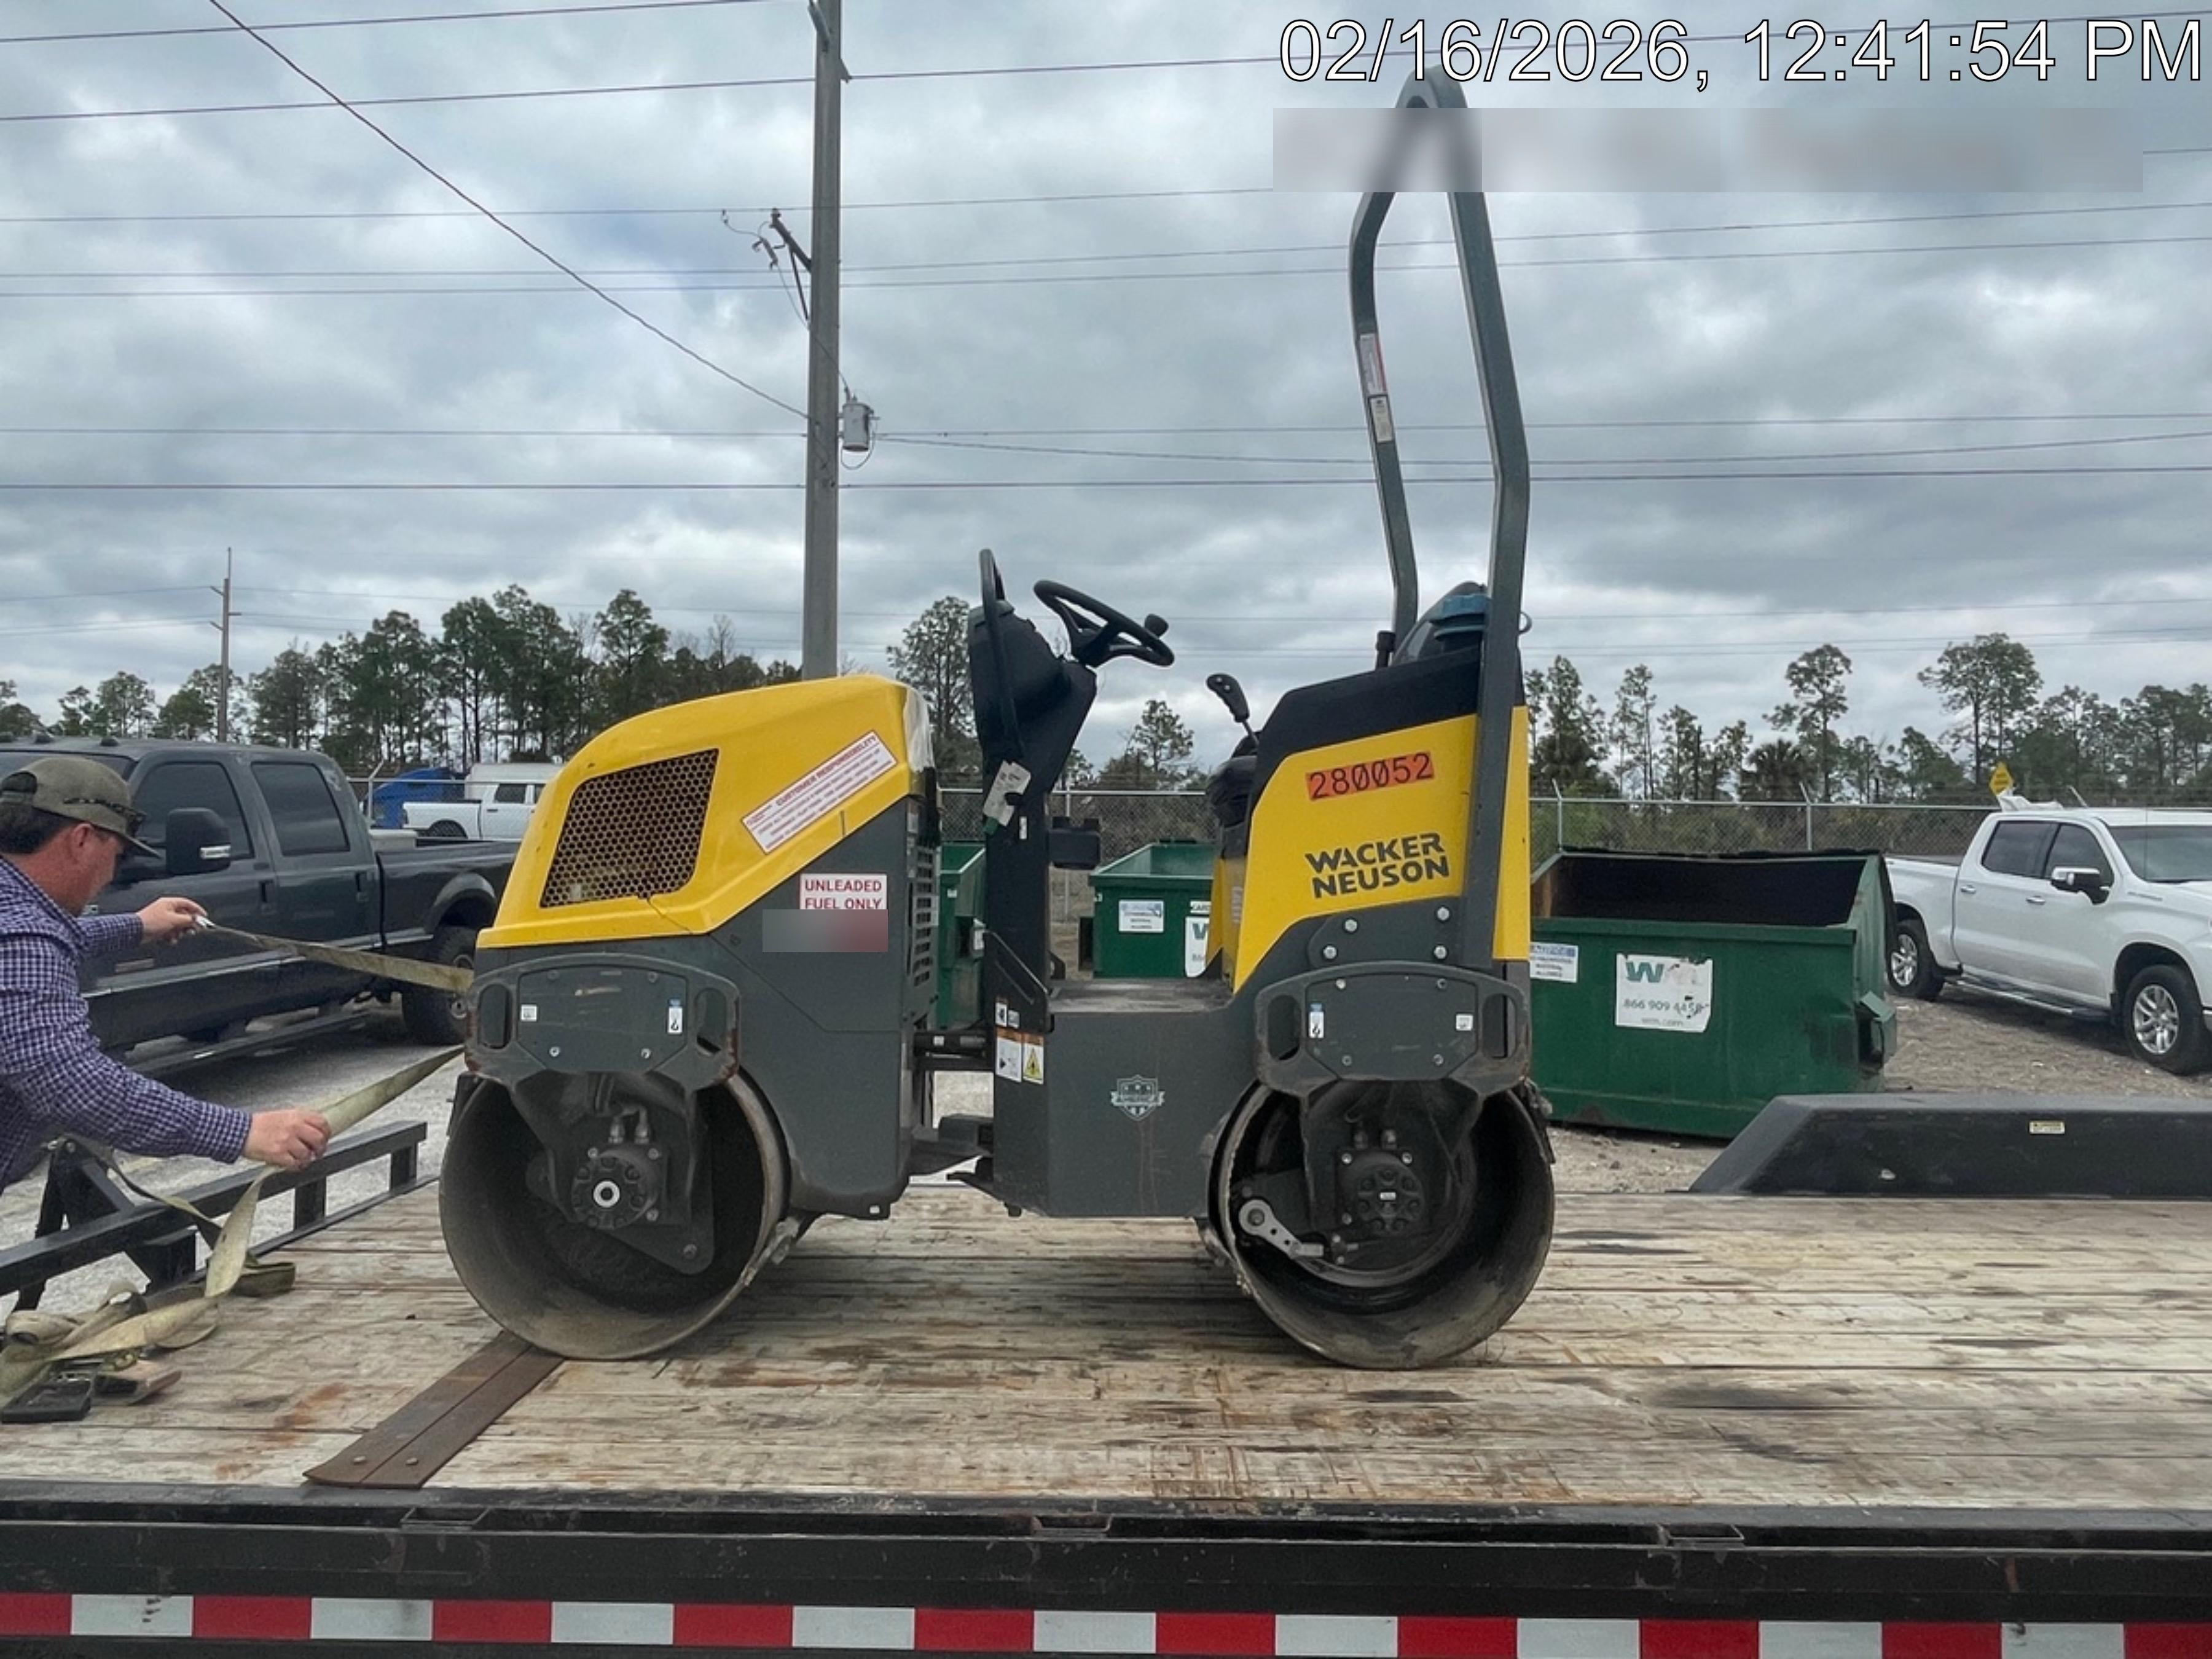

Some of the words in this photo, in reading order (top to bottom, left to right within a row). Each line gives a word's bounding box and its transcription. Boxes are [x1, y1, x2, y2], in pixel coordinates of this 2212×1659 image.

[775, 775, 817, 806] CUSTOMER
[1309, 752, 1433, 799] 280052
[1304, 833, 1446, 874] WACKER
[805, 879, 882, 892] UNLEADED
[1312, 856, 1449, 899] NEUSON
[805, 897, 841, 909] FUEL
[844, 897, 882, 909] ONLY
[1648, 1000, 1671, 1011] 909
